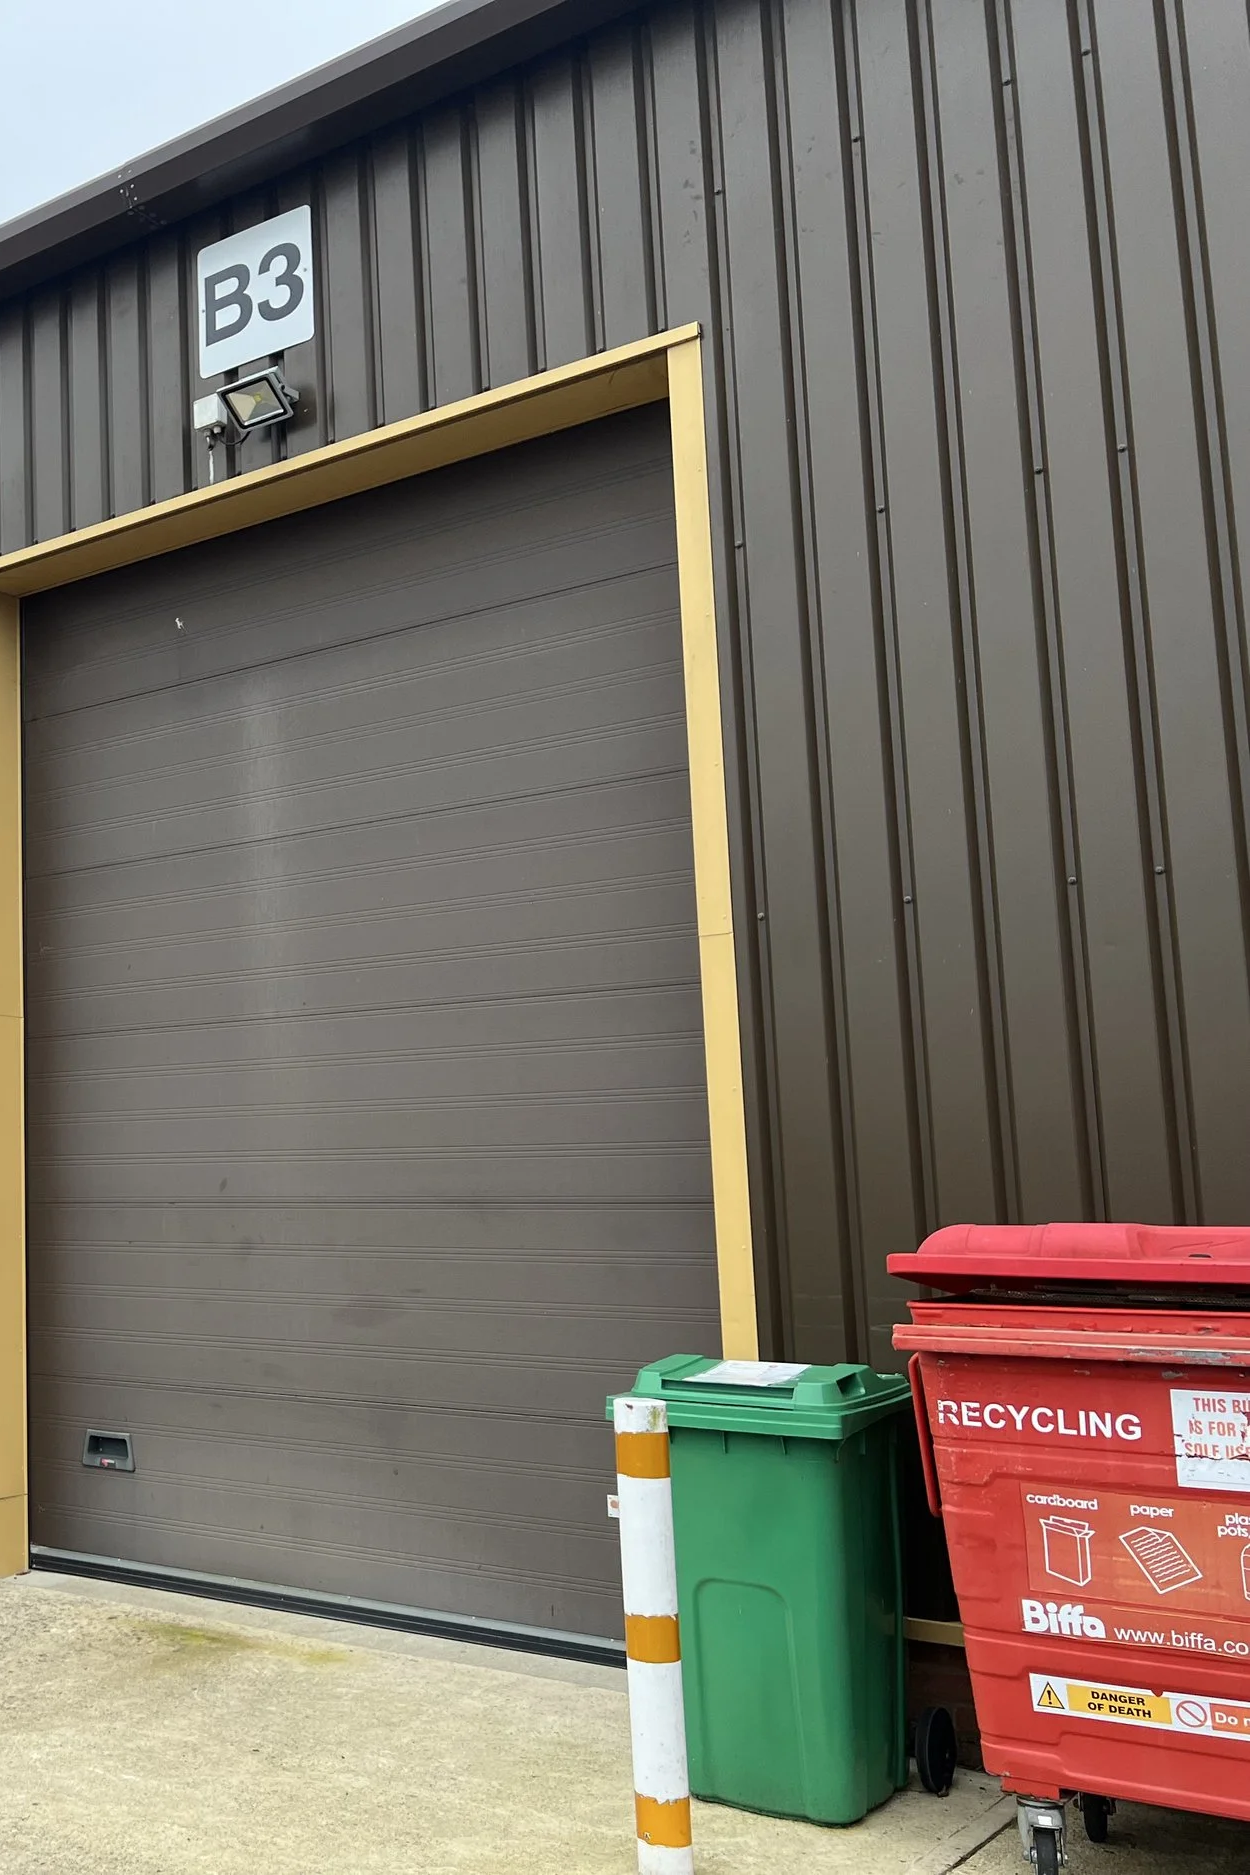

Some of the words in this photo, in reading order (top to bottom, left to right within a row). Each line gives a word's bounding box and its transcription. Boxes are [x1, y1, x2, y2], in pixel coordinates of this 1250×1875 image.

[204, 242, 304, 347] B3
[1193, 1398, 1226, 1413] THIS
[937, 1400, 1142, 1440] RECYCLING
[1188, 1420, 1203, 1435] IS
[1208, 1421, 1237, 1437] FOR
[1026, 1494, 1098, 1510] cardboard
[1130, 1504, 1174, 1518] paper
[1225, 1512, 1250, 1526] pla
[1022, 1599, 1106, 1639] Biffa
[1091, 1690, 1145, 1706] DANGER
[1087, 1701, 1104, 1711] OF
[1108, 1704, 1152, 1718] DEATH
[1215, 1711, 1238, 1726] Do
